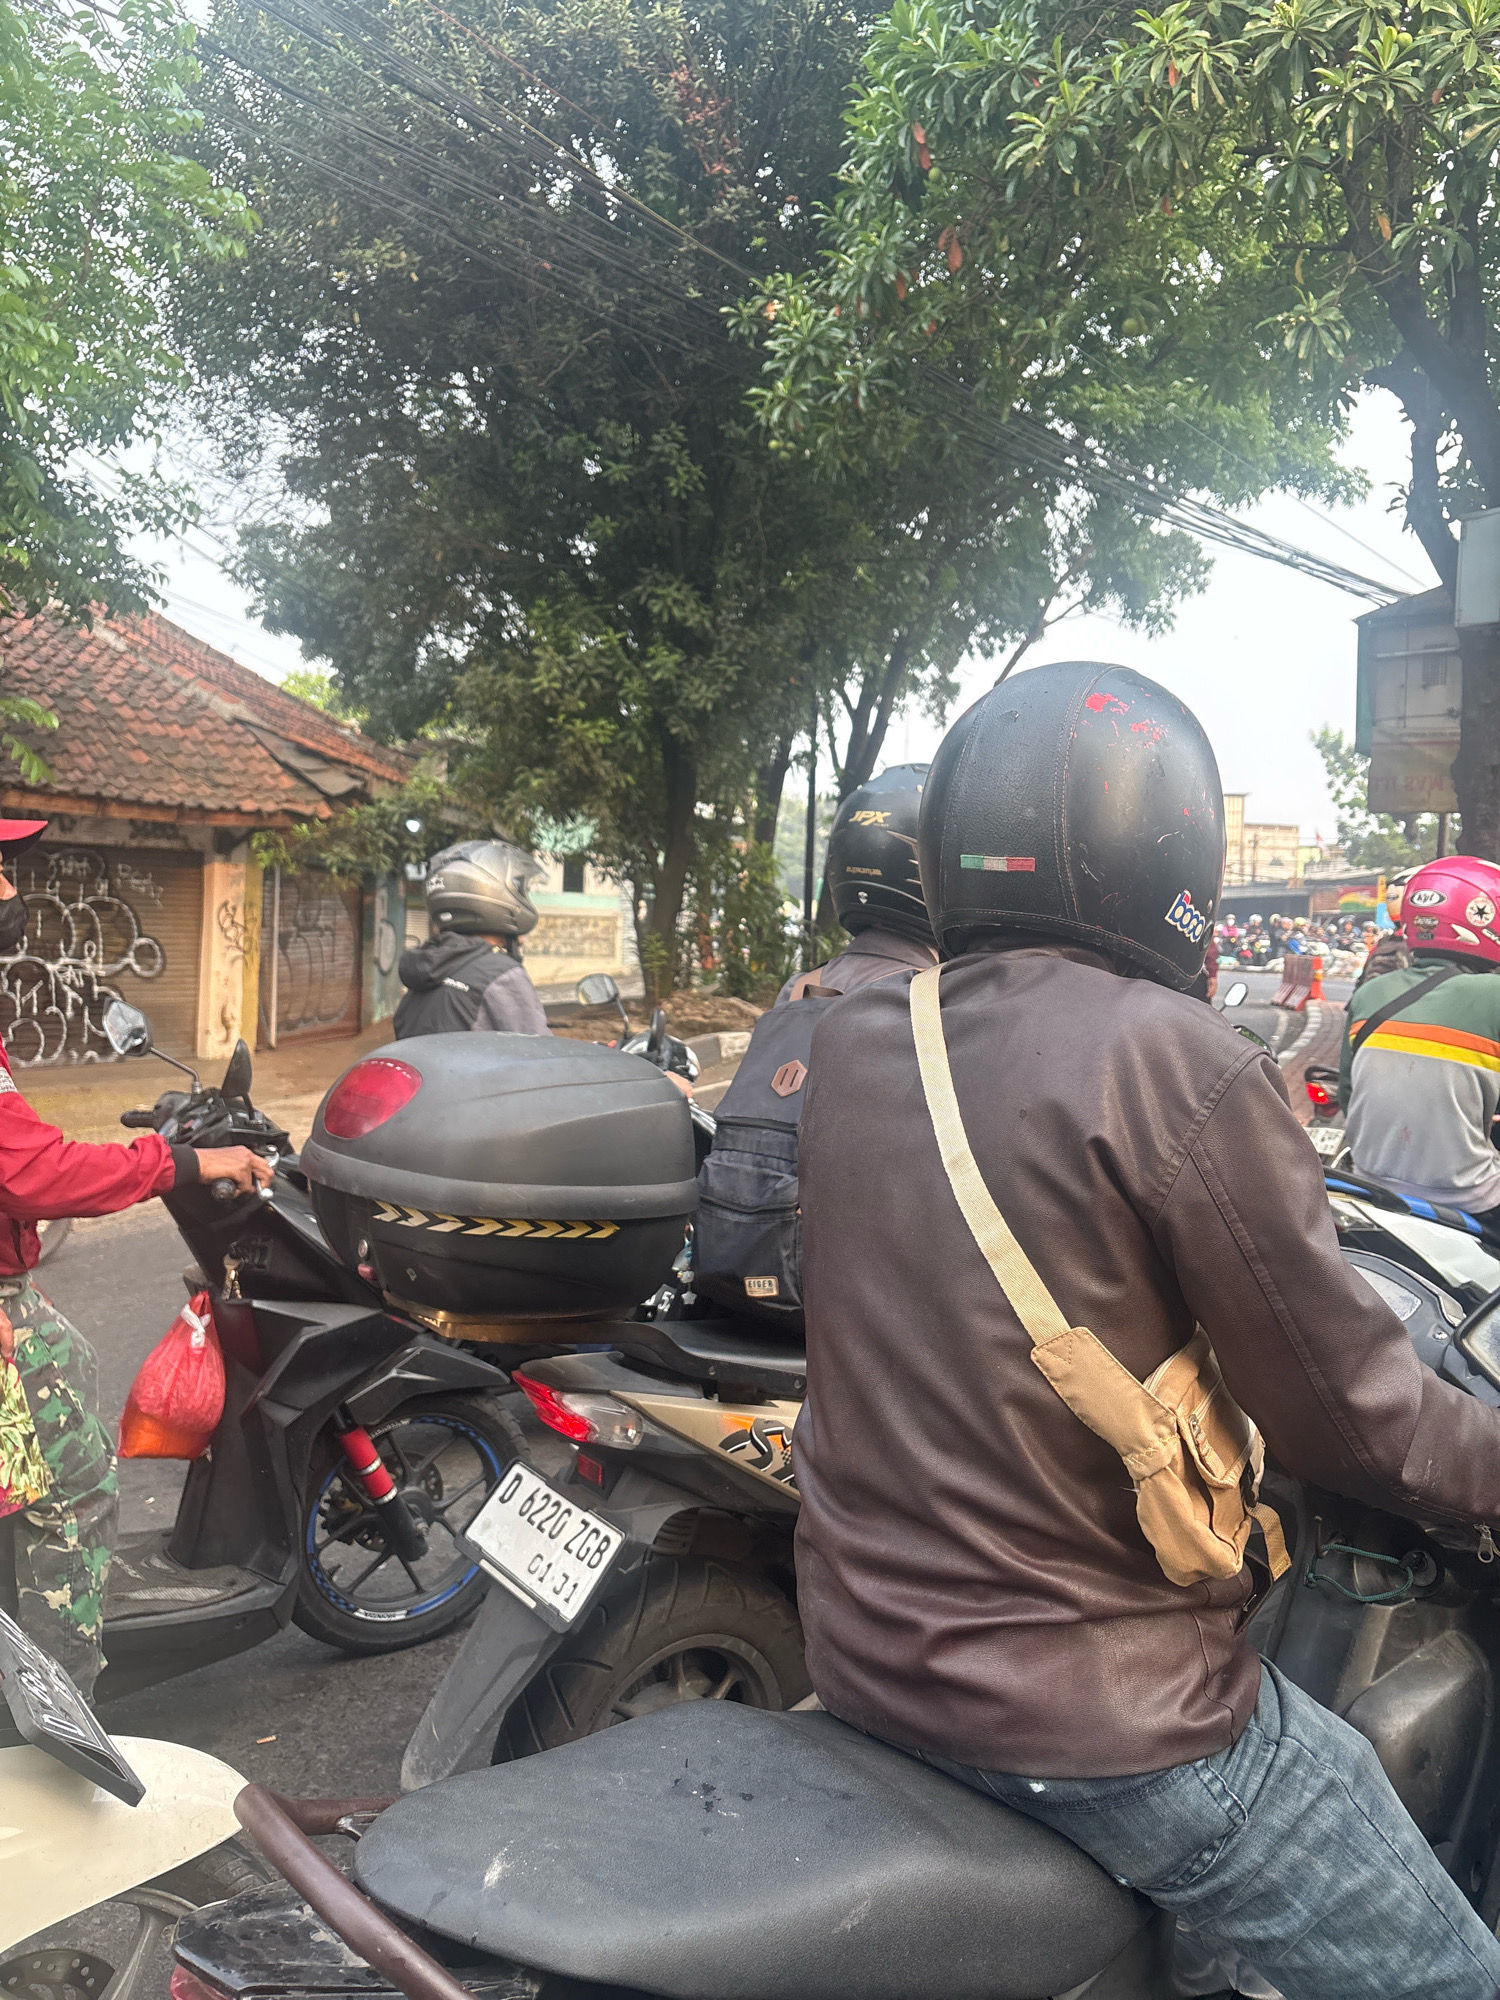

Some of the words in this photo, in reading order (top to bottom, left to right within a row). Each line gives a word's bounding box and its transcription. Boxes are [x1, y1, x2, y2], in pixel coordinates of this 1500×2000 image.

[848, 810, 892, 826] JPX
[747, 1280, 773, 1288] EIGER
[499, 1473, 524, 1504] D
[518, 1487, 574, 1540] 6220
[563, 1519, 612, 1570] ZGB
